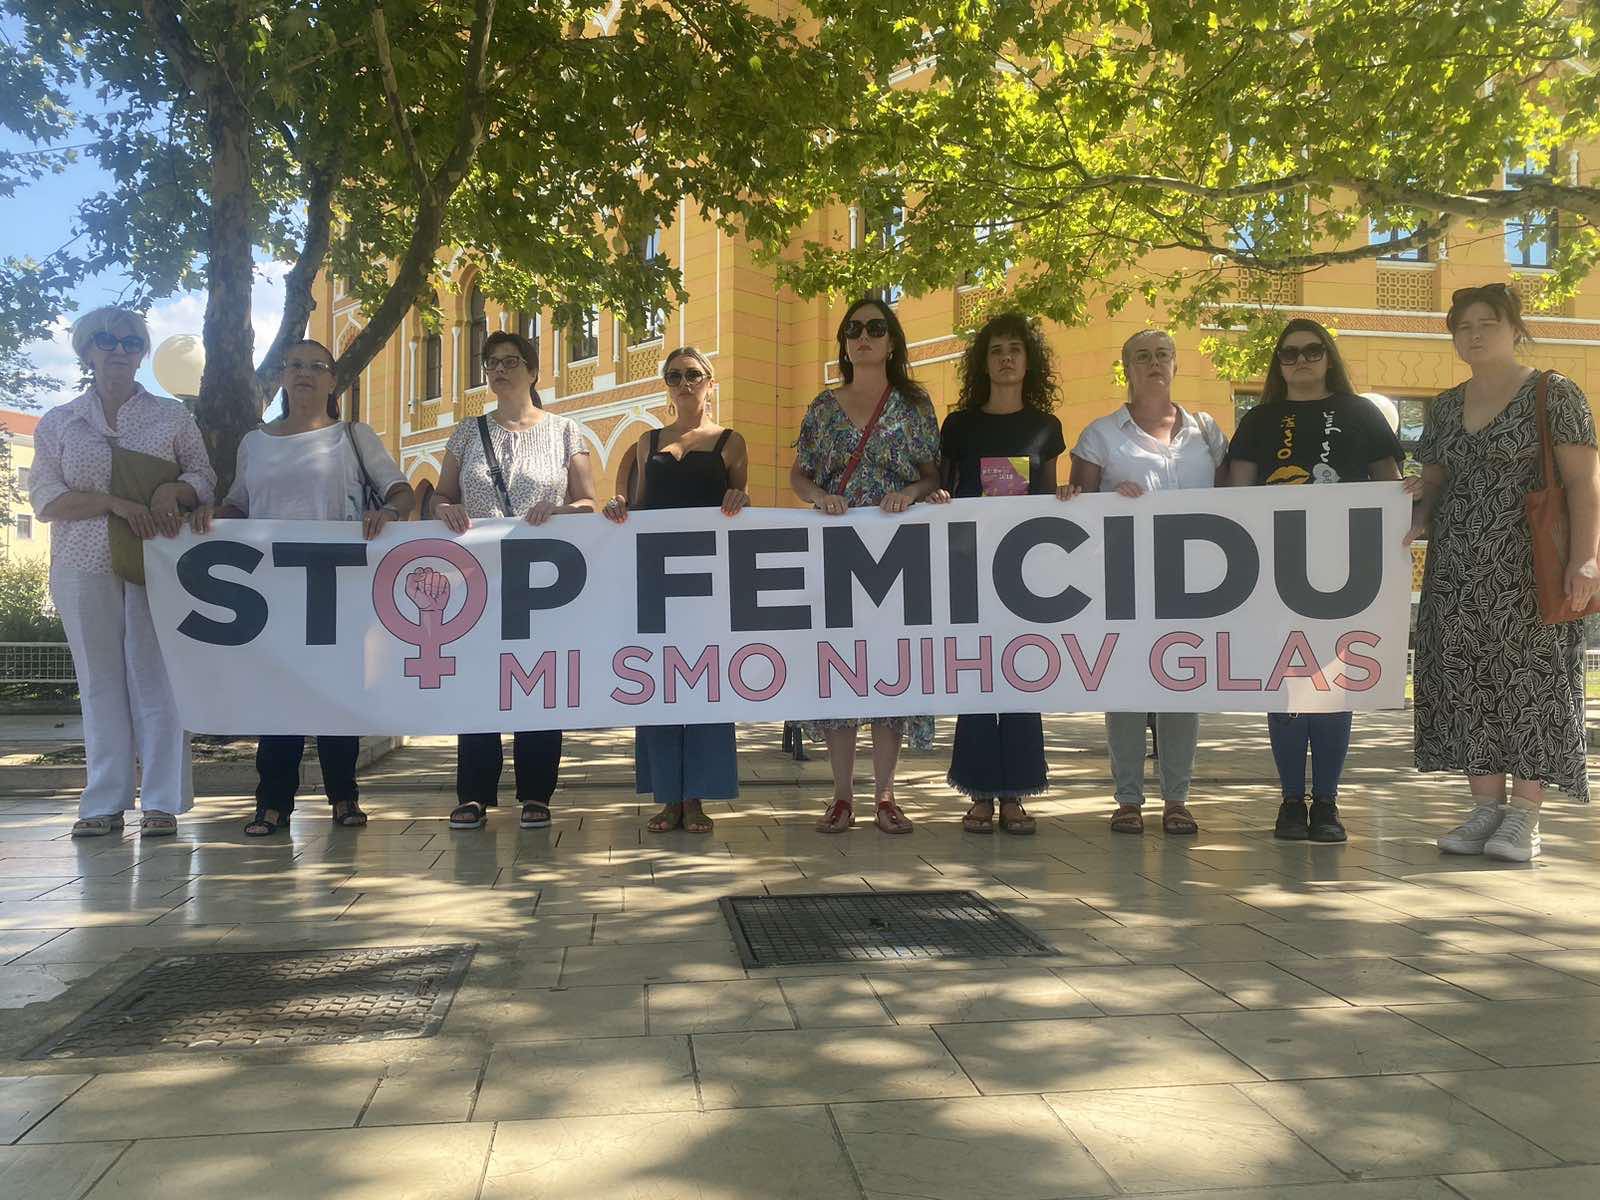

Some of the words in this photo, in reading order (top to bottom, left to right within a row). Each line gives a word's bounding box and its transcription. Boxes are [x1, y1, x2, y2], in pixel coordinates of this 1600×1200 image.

[176, 538, 588, 648] STOP
[636, 507, 1383, 634] FEMICIDU
[499, 649, 581, 711] MI
[611, 642, 787, 706] SMO
[816, 632, 1120, 699] NJIHOV
[1148, 630, 1382, 692] GLAS
